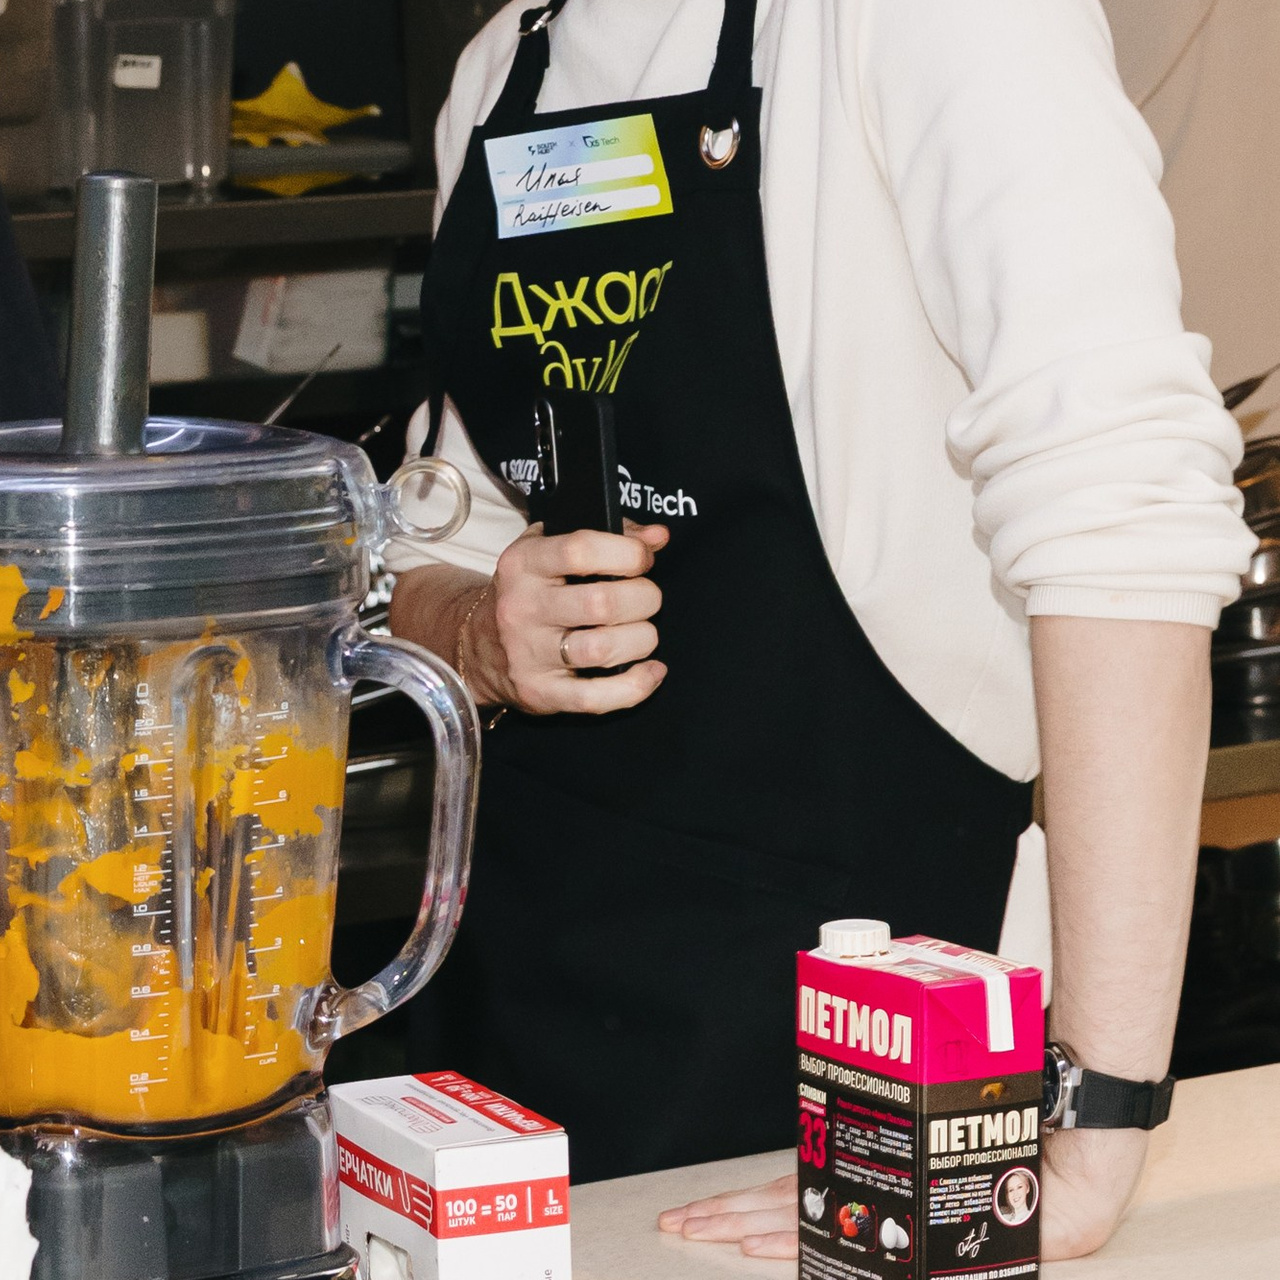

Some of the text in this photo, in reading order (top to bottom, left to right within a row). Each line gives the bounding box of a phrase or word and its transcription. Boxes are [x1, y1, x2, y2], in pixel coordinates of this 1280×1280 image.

[601, 136, 620, 146] Tech
[644, 485, 698, 517] Tech
[134, 825, 148, 834] 1.4
[799, 984, 913, 1065] ПЕТМОЛ
[799, 1053, 911, 1105] ВЫБОР ПРОФЕССИОНАЛОВ
[798, 1111, 827, 1169] 33
[928, 1106, 1039, 1154] ПЕТМОЛ
[929, 1143, 1039, 1170] ВЫБОР ПРОФЕССИОНАЛОВ
[339, 1148, 394, 1201] ЕРЧАТКИ
[445, 1198, 477, 1217] 100
[495, 1194, 518, 1211] 50
[547, 1189, 559, 1205] L
[543, 1205, 564, 1216] SIZE
[448, 1212, 517, 1228] ШТУК ПАР
[989, 1270, 998, 1280] ПО
